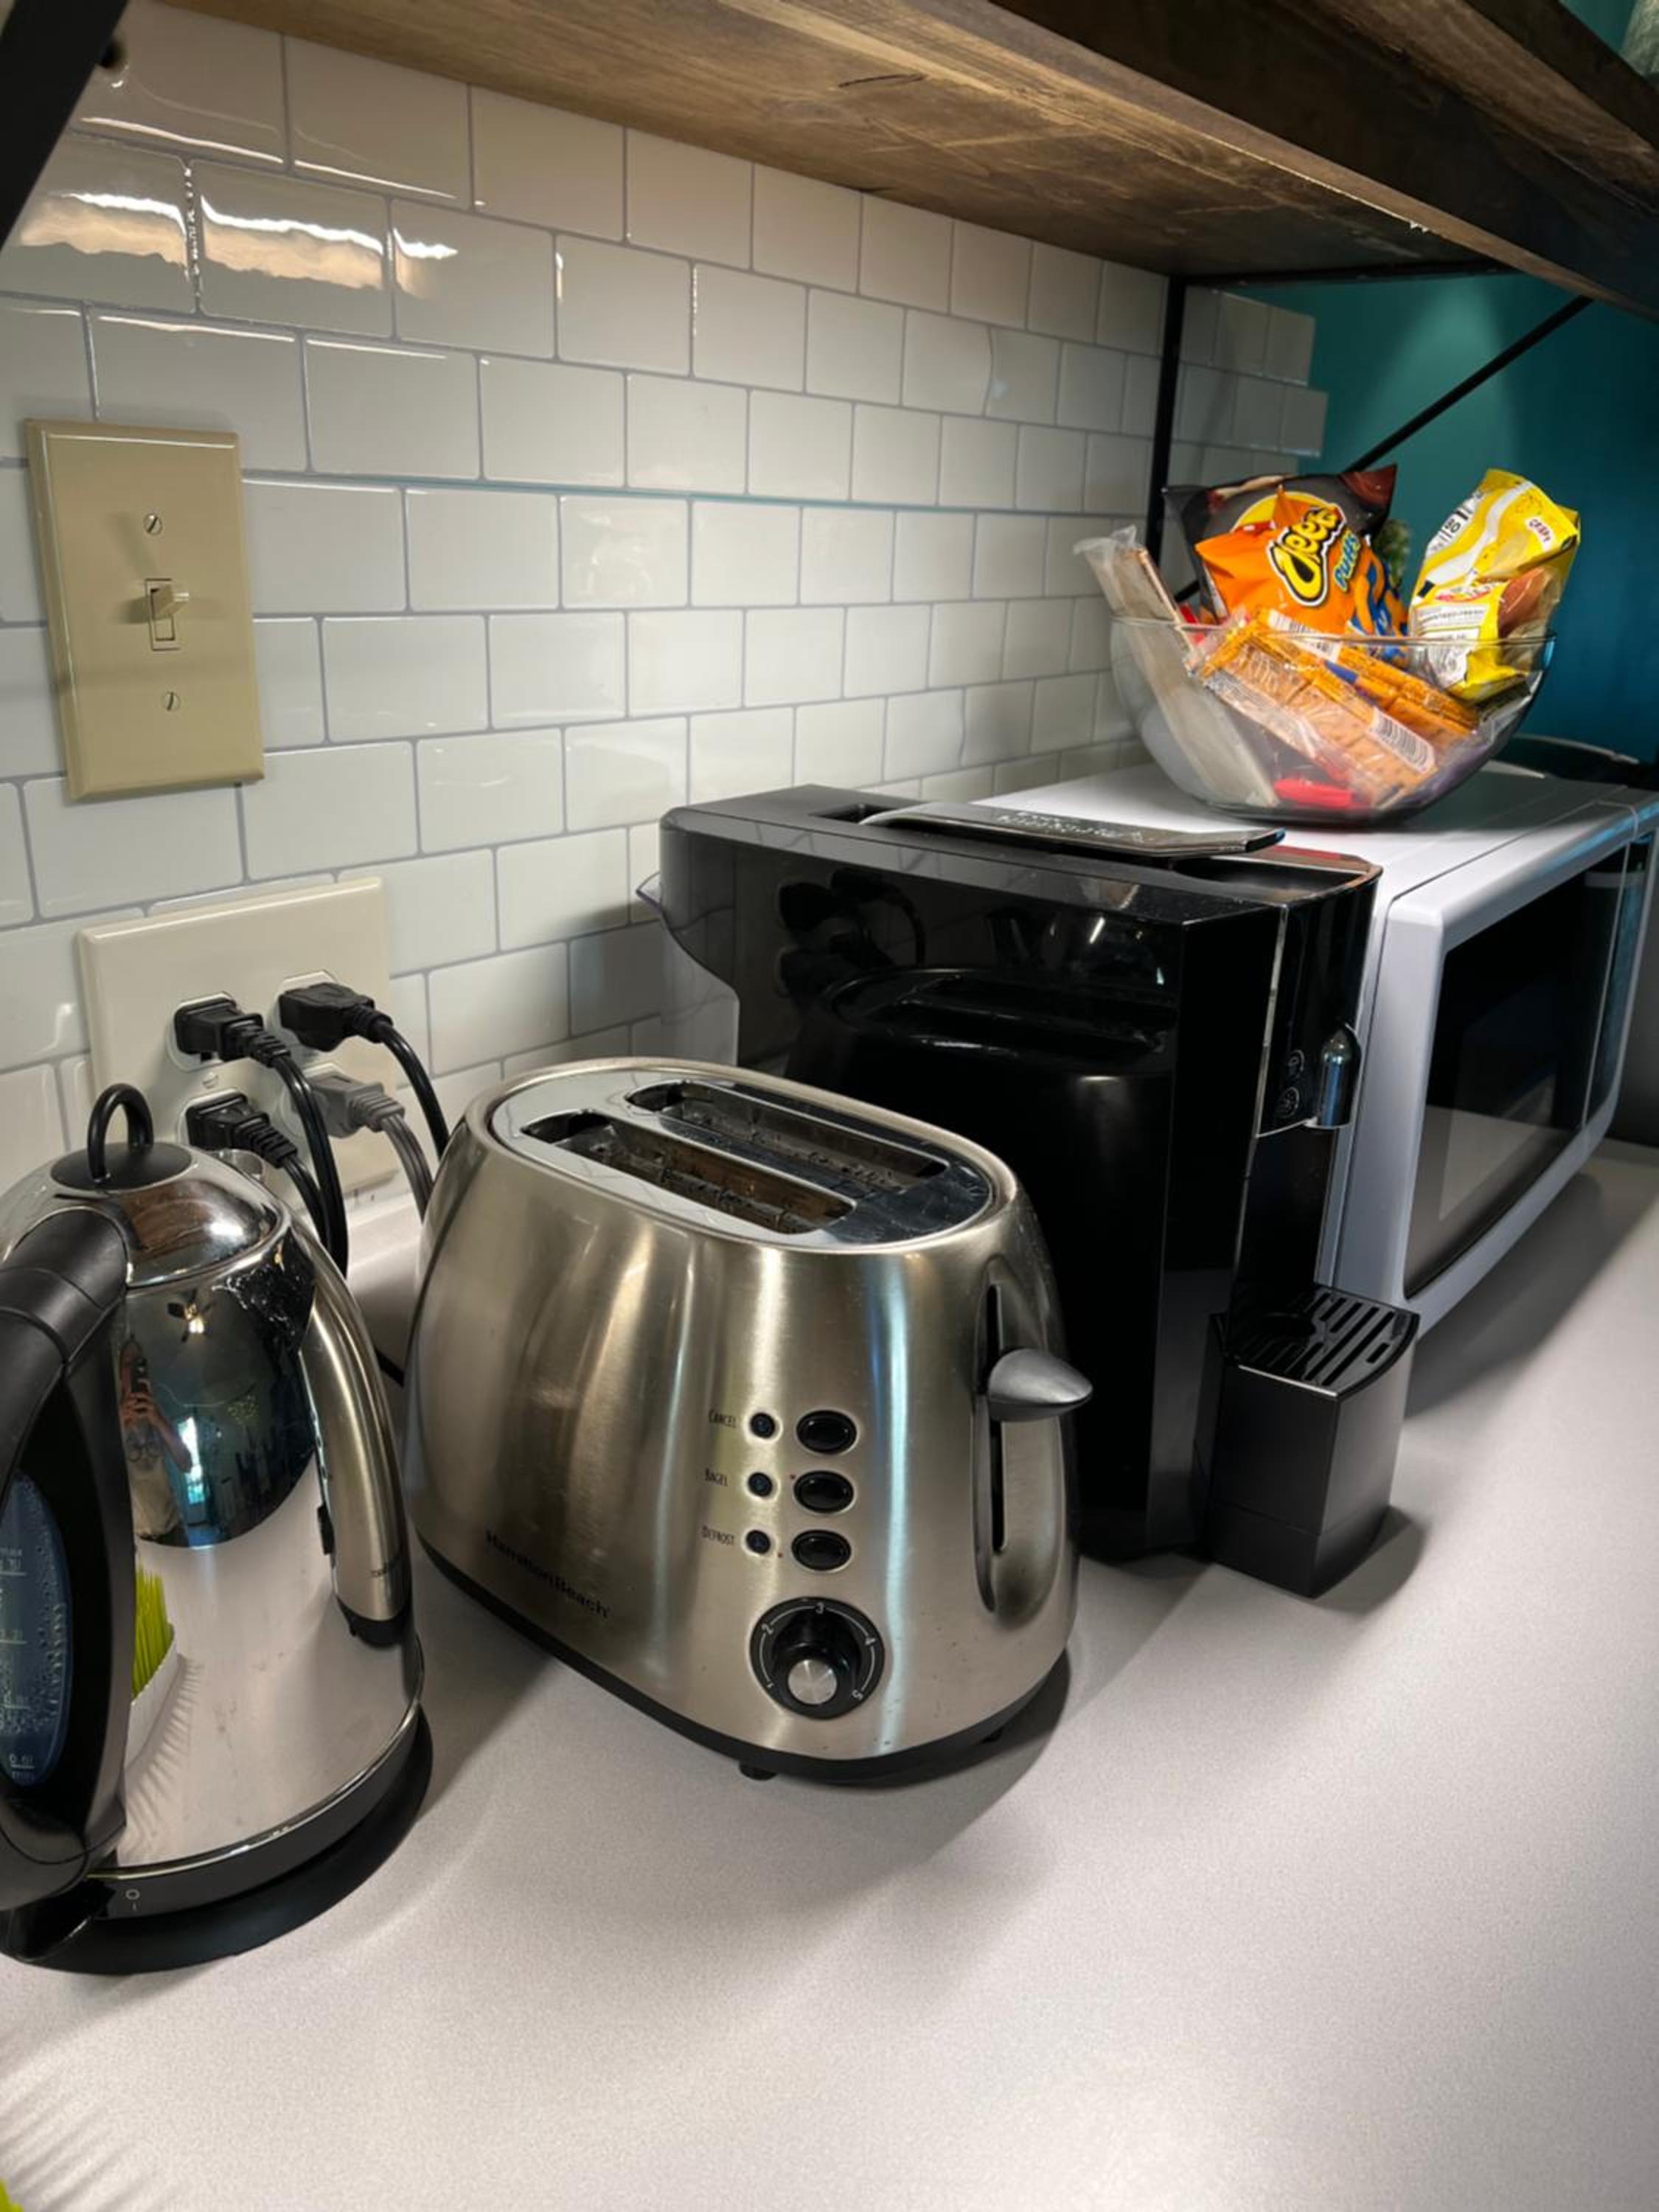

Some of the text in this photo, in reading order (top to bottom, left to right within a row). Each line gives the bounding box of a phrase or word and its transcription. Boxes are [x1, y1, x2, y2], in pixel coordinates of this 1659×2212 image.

[1335, 530, 1360, 591] Puffs
[707, 1408, 737, 1428] CANCEL
[703, 1467, 728, 1487] BAGEL
[701, 1524, 736, 1546] DEFROST
[814, 1602, 825, 1614] 3
[761, 1622, 774, 1635] 2
[865, 1636, 877, 1646] 4
[851, 1689, 863, 1700] 5
